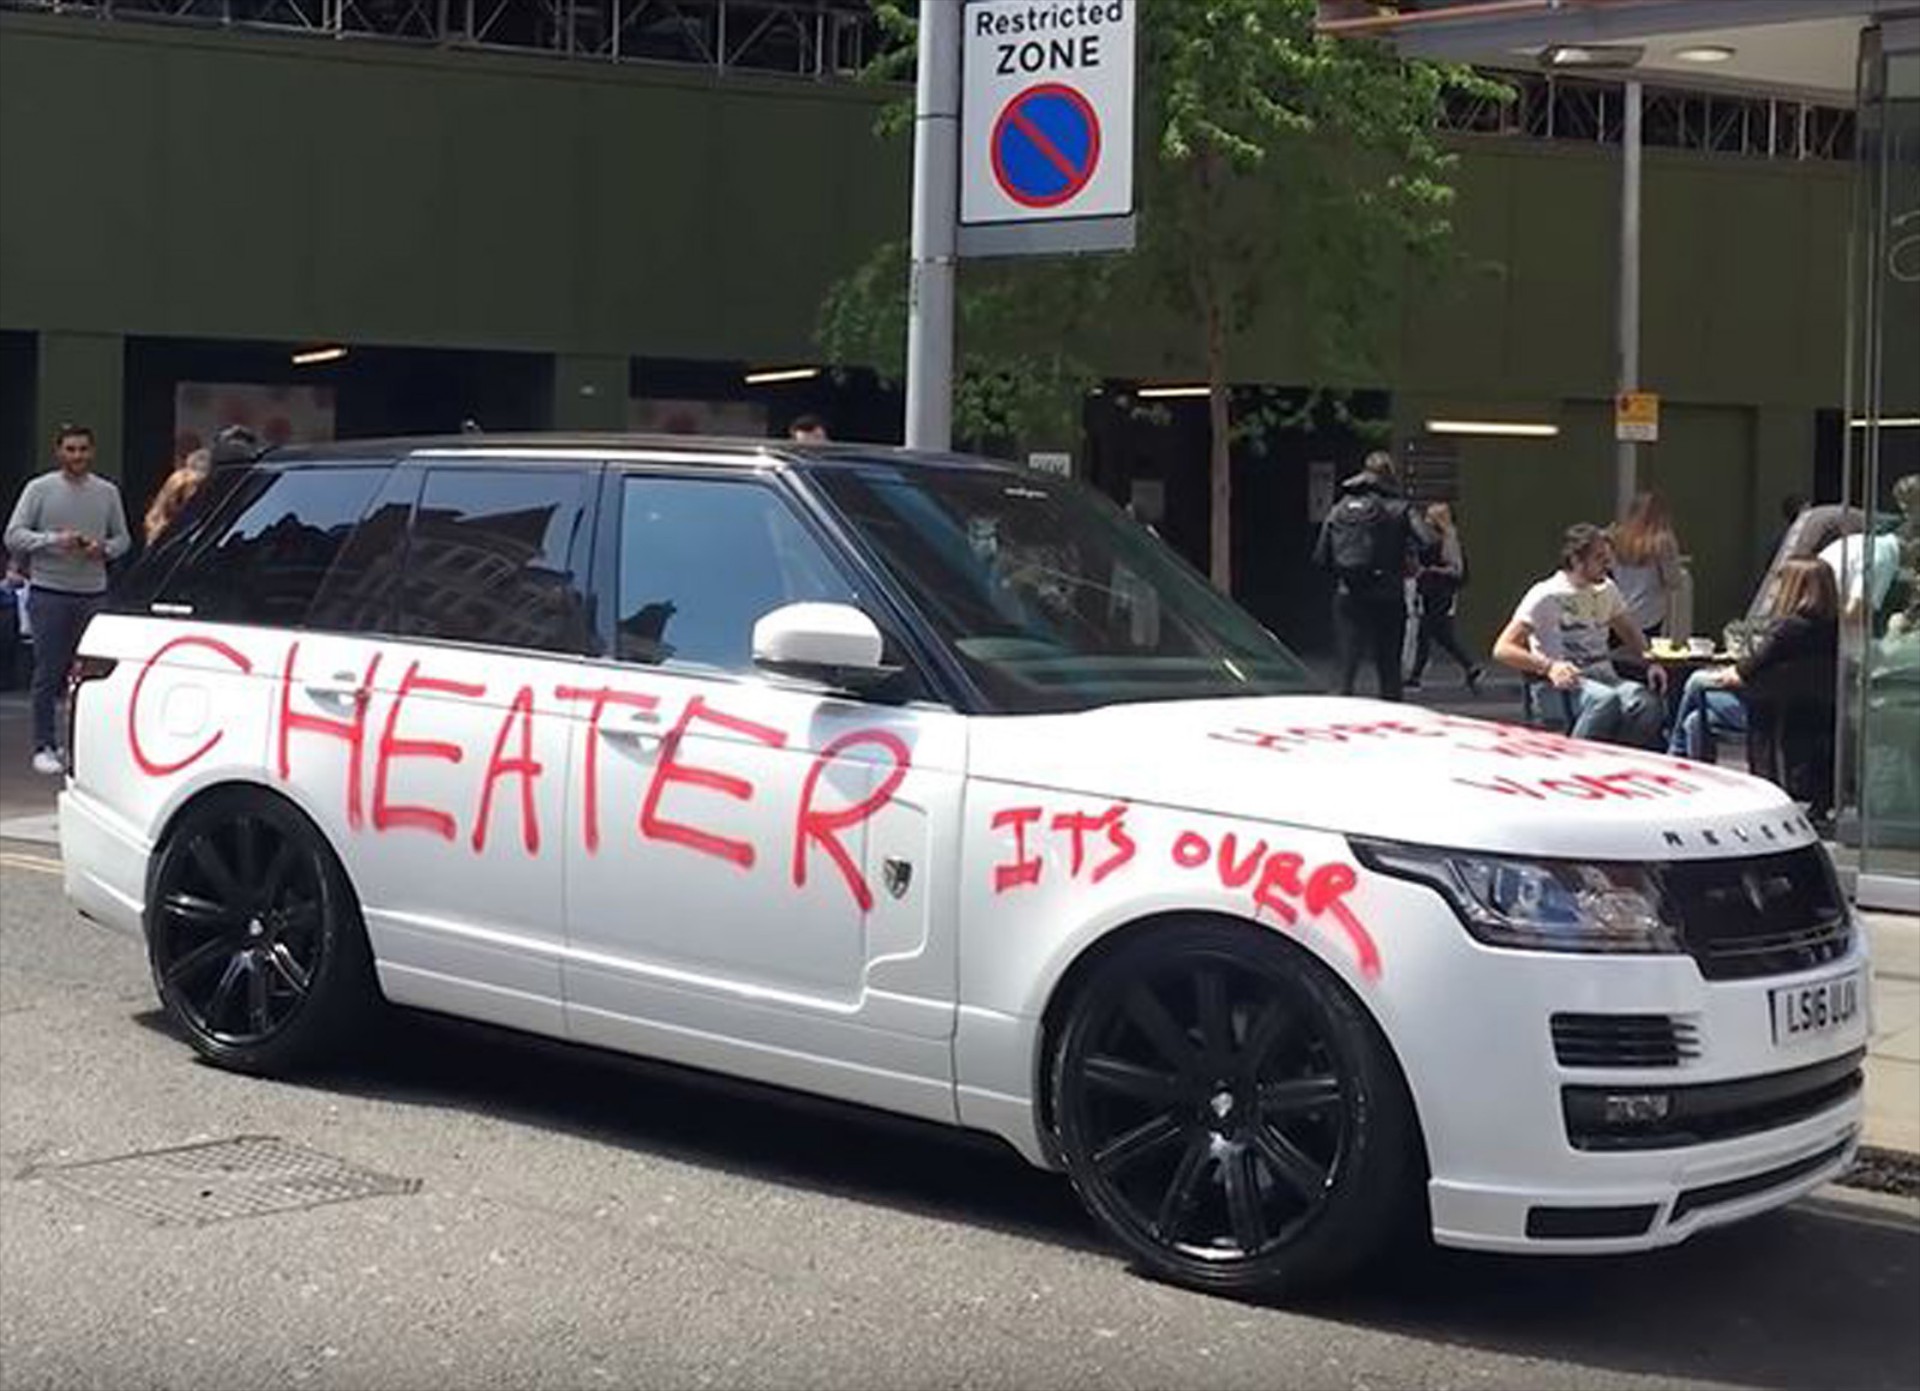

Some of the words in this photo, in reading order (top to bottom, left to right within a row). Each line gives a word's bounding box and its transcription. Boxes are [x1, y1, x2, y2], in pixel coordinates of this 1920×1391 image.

[976, 0, 1123, 36] Restricted
[997, 36, 1101, 75] ZONE
[128, 636, 910, 910] CHEATER
[991, 805, 1136, 890] IT'S
[1171, 831, 1381, 978] OVER
